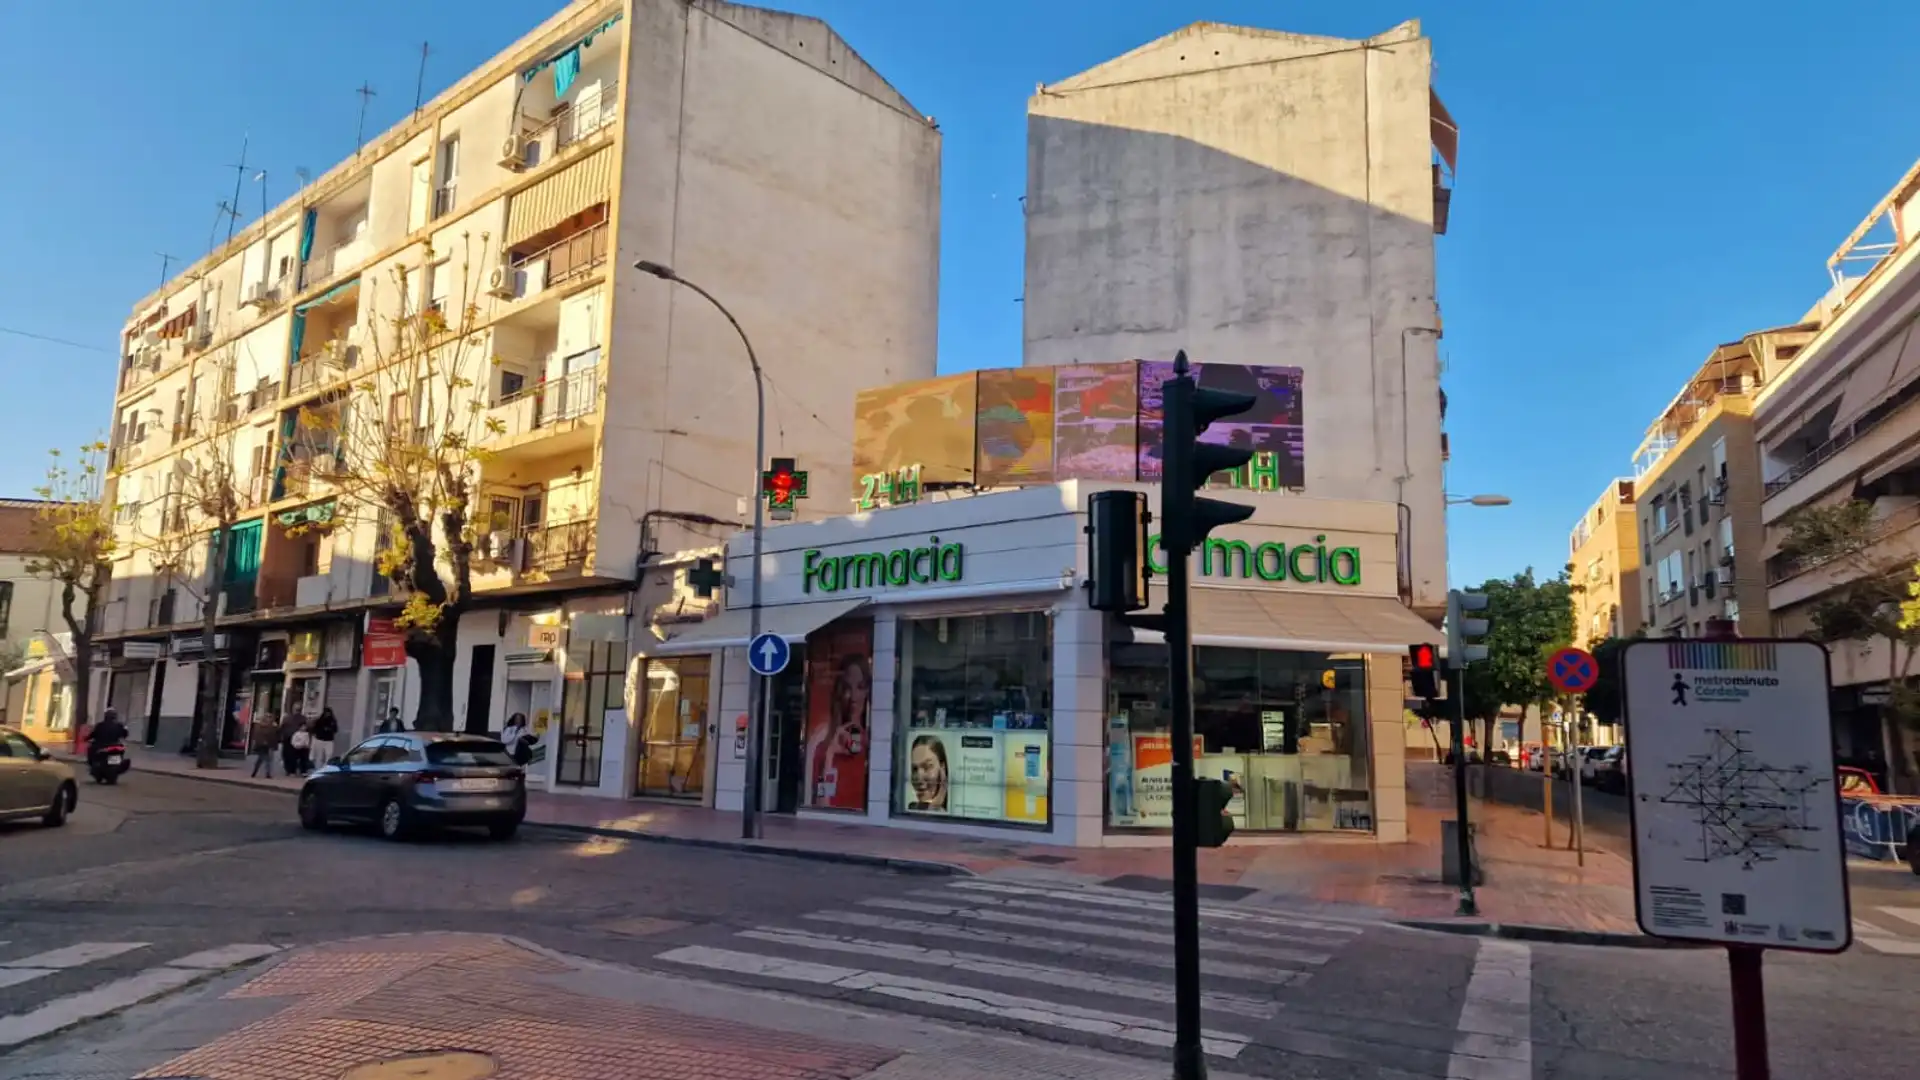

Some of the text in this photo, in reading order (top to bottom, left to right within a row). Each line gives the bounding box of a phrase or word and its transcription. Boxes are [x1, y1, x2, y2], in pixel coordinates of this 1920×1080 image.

[860, 463, 921, 508] 24H
[803, 535, 963, 594] Farmacia
[1694, 675, 1779, 687] metrominuto
